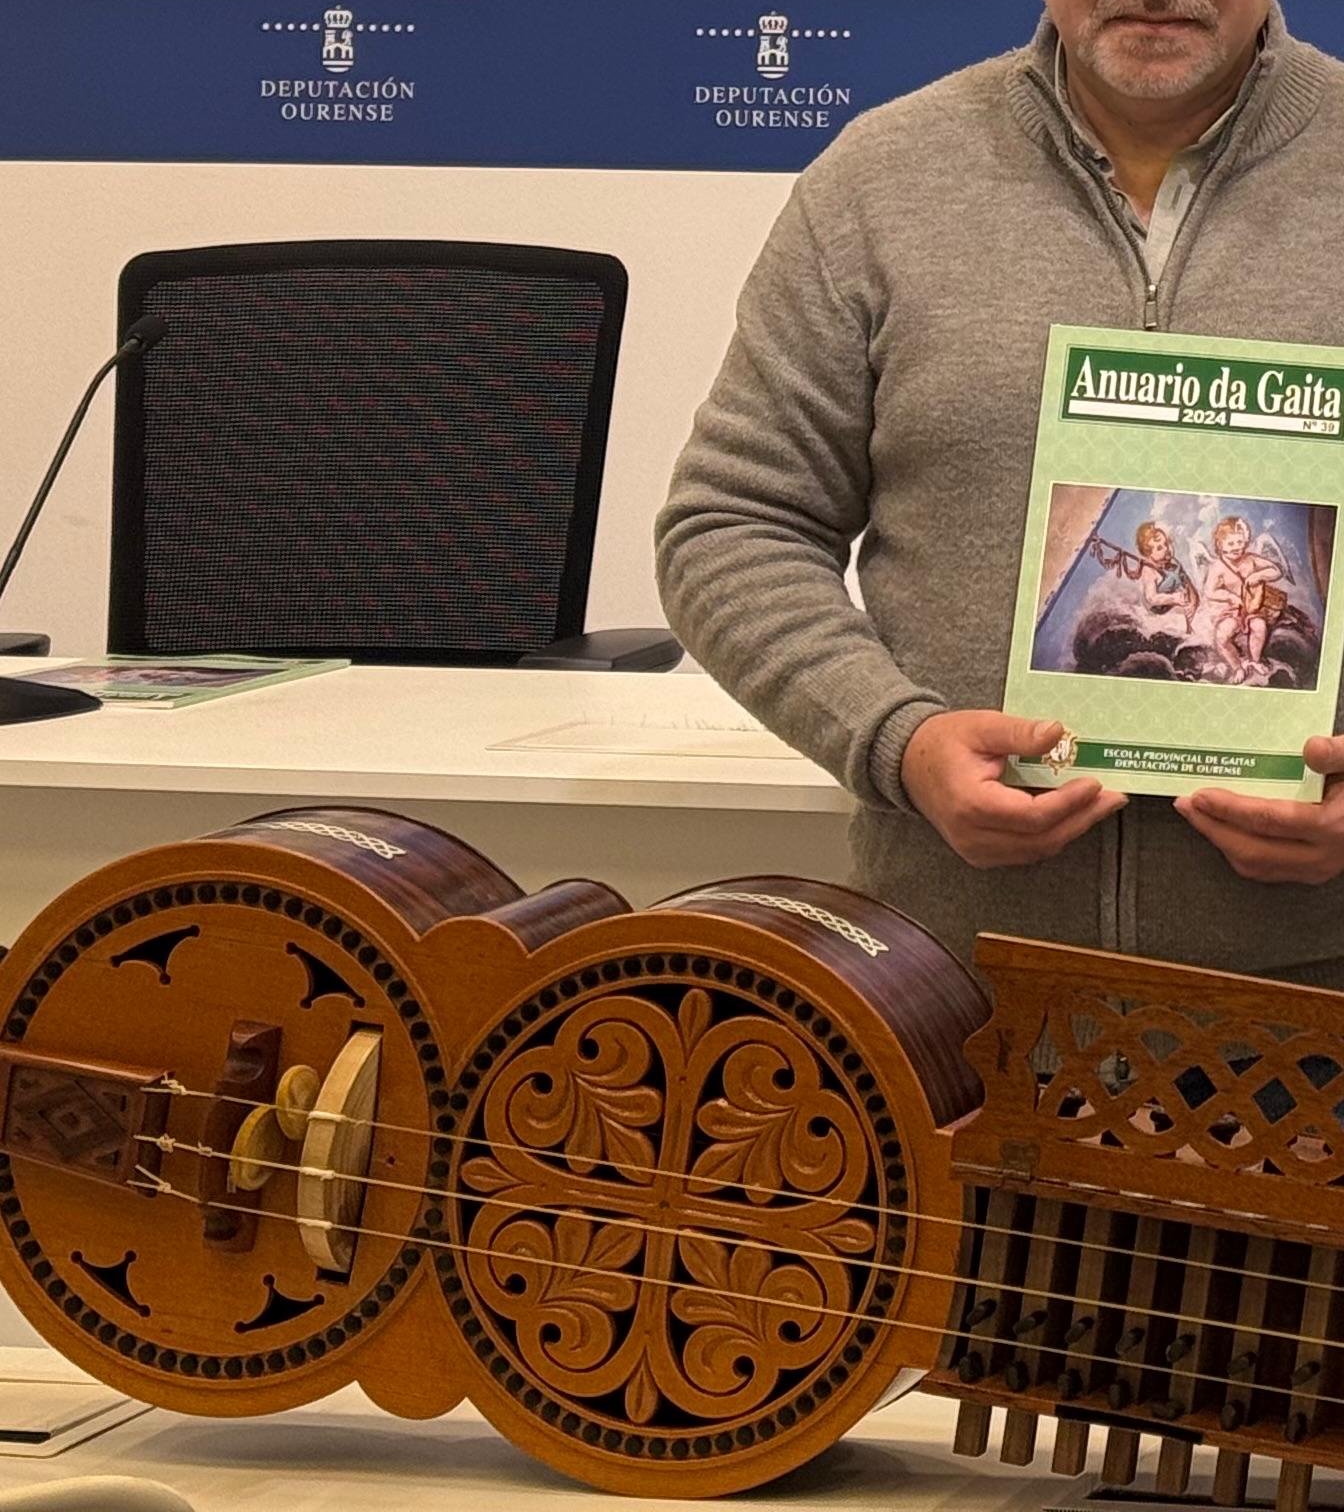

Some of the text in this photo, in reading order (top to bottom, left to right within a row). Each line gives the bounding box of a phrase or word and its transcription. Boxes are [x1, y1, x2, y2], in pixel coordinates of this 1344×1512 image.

[259, 76, 416, 100] DEPUTACIÓN
[694, 83, 852, 106] DEPUTACIÓN
[280, 102, 395, 122] OURENSE
[714, 108, 830, 128] OURENSE
[1070, 354, 1342, 419] Anuario da Gaita
[1181, 408, 1229, 427] 2024
[1103, 748, 1257, 768] ESCOLA PROVINCIAL DE GAITAS
[1180, 763, 1195, 774] DE
[1197, 764, 1242, 776] OURENSE
